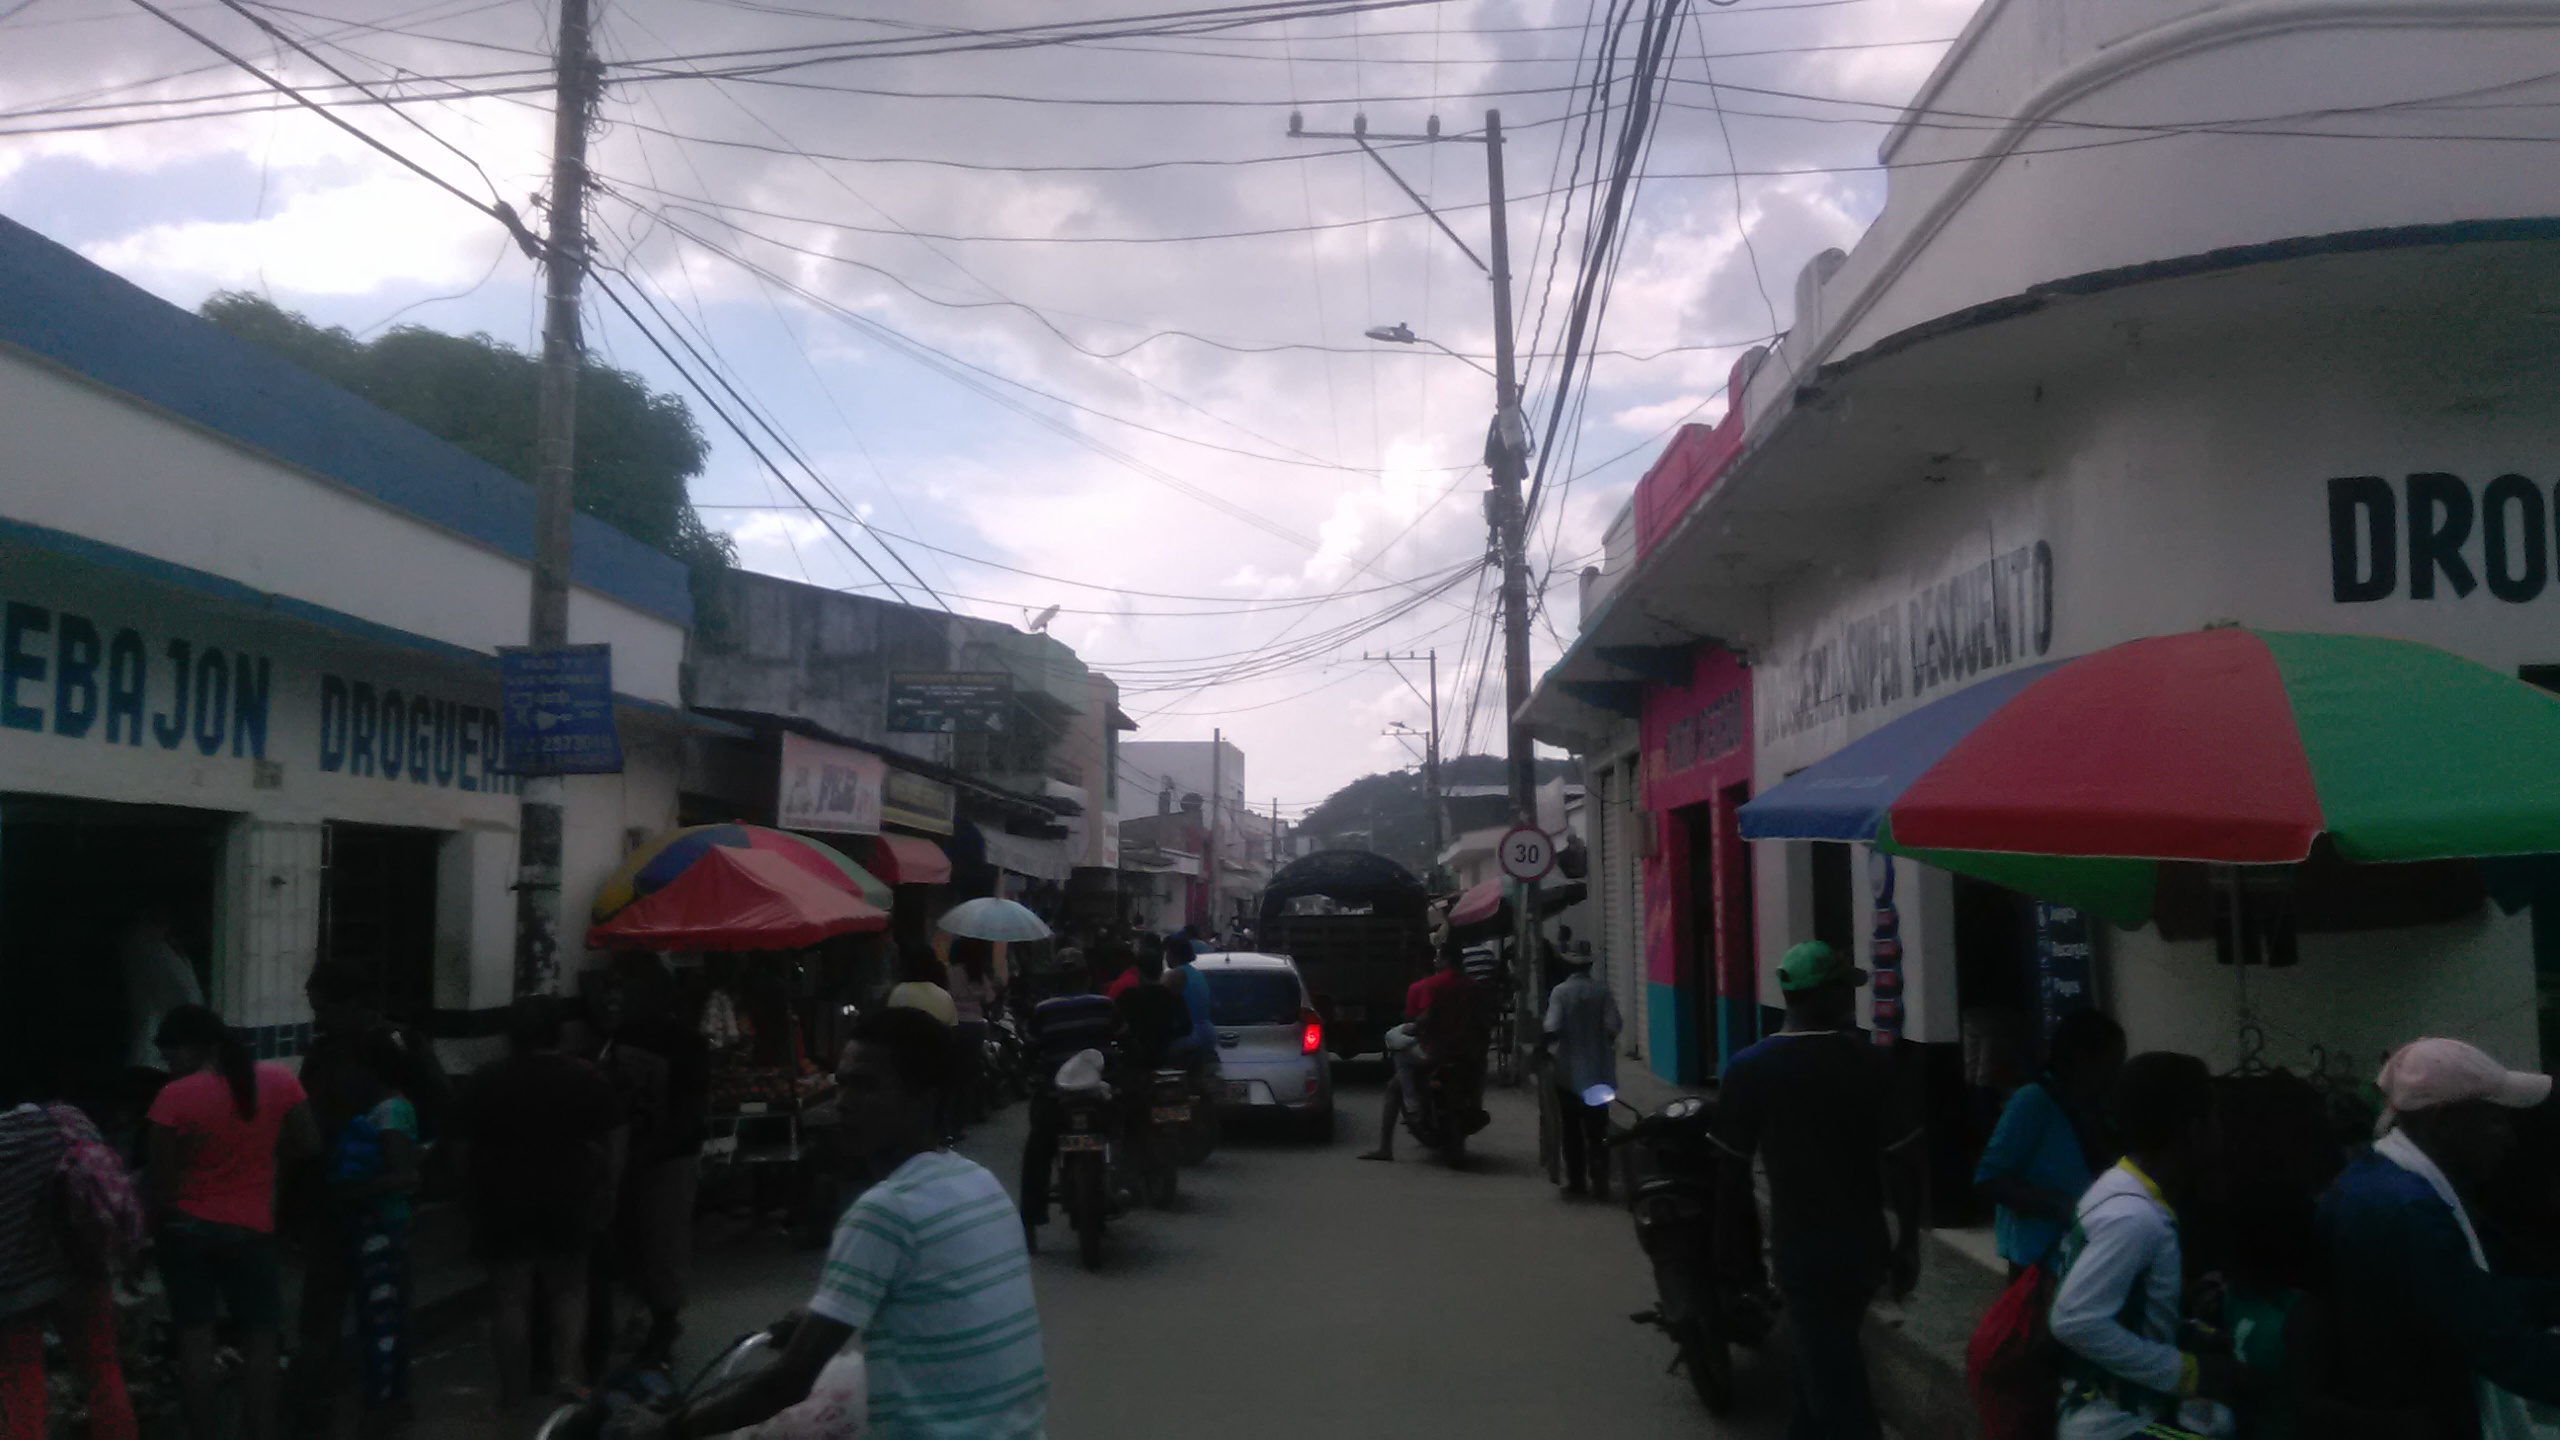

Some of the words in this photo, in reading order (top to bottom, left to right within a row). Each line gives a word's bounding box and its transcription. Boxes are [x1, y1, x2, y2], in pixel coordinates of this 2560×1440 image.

[2327, 471, 2560, 602] DRO
[1909, 539, 2054, 697] DESCUENTO
[1, 601, 270, 760] EBAJON
[319, 673, 525, 796] DROGUER
[1515, 844, 1539, 864] 30
